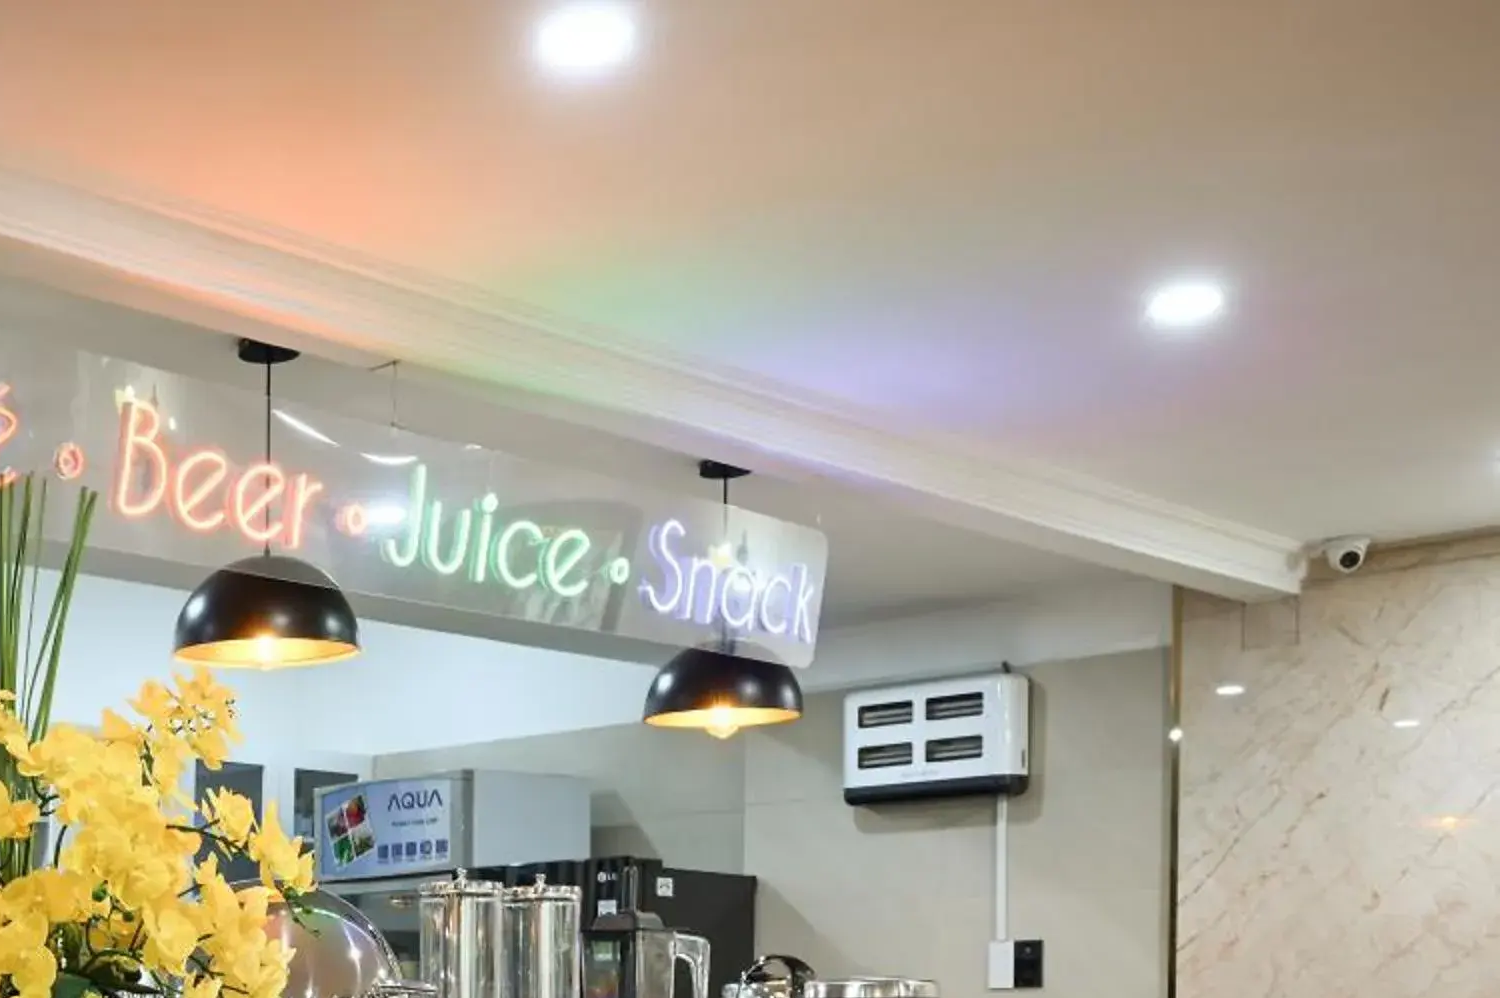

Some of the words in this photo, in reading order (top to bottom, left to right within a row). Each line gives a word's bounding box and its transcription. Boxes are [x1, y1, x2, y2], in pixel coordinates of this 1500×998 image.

[111, 399, 322, 549] Beer
[378, 464, 592, 597] Juice
[643, 519, 815, 645] Snack
[388, 789, 443, 812] AQUA
